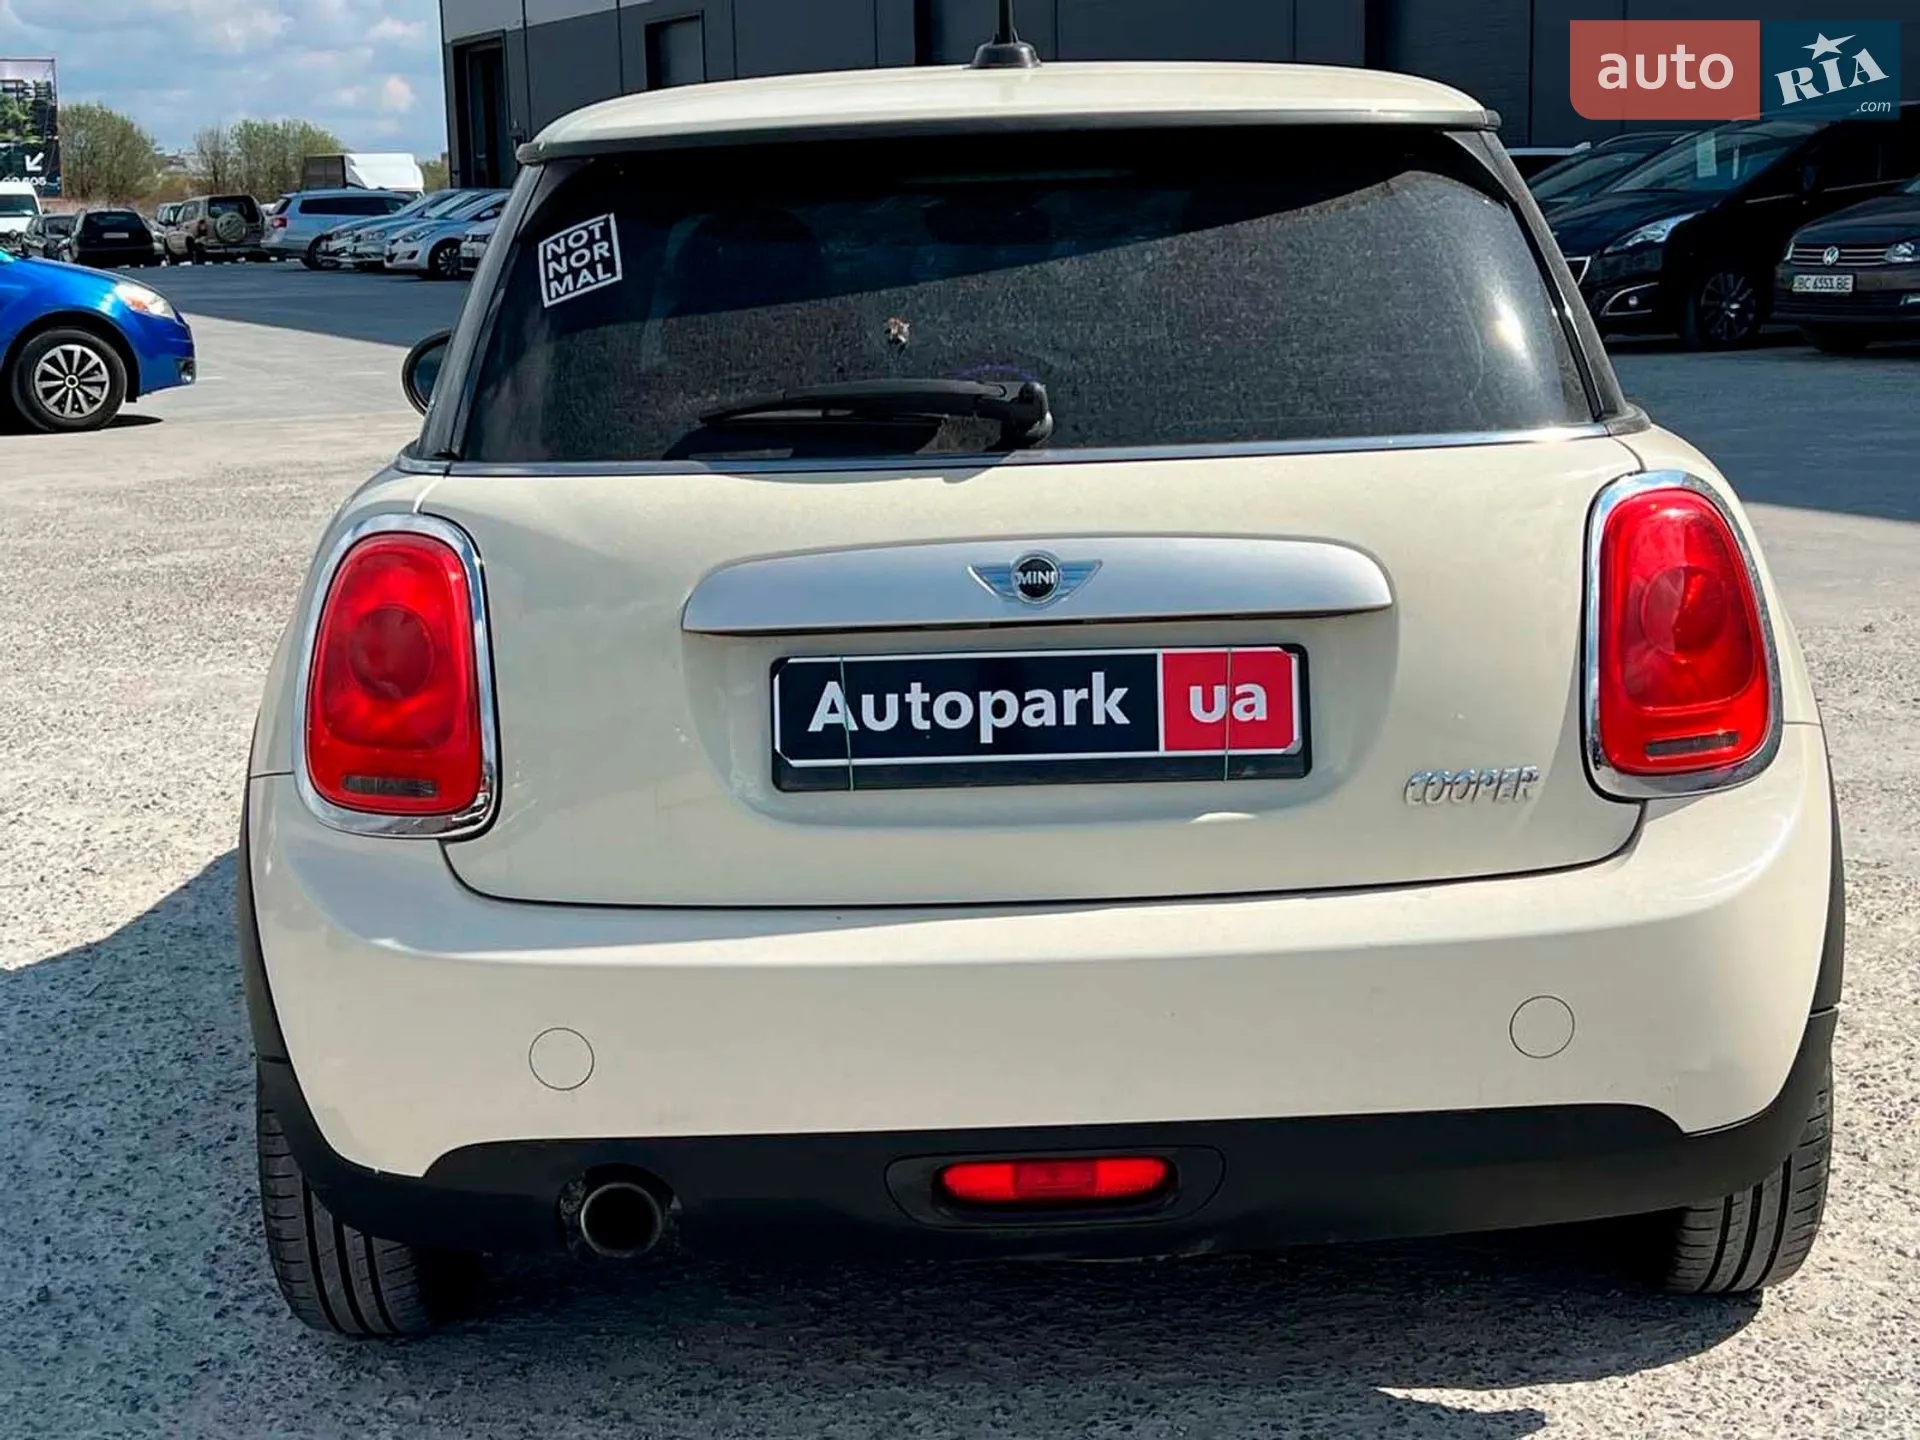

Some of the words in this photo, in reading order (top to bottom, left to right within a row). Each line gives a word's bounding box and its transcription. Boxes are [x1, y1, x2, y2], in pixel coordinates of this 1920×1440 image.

[546, 222, 605, 260] NOT
[548, 241, 611, 279] NOR
[550, 263, 612, 299] MAL
[1015, 570, 1058, 585] MINI
[808, 671, 1130, 744] Autopark
[1189, 681, 1268, 723] ua
[1404, 765, 1540, 806] COOPER
